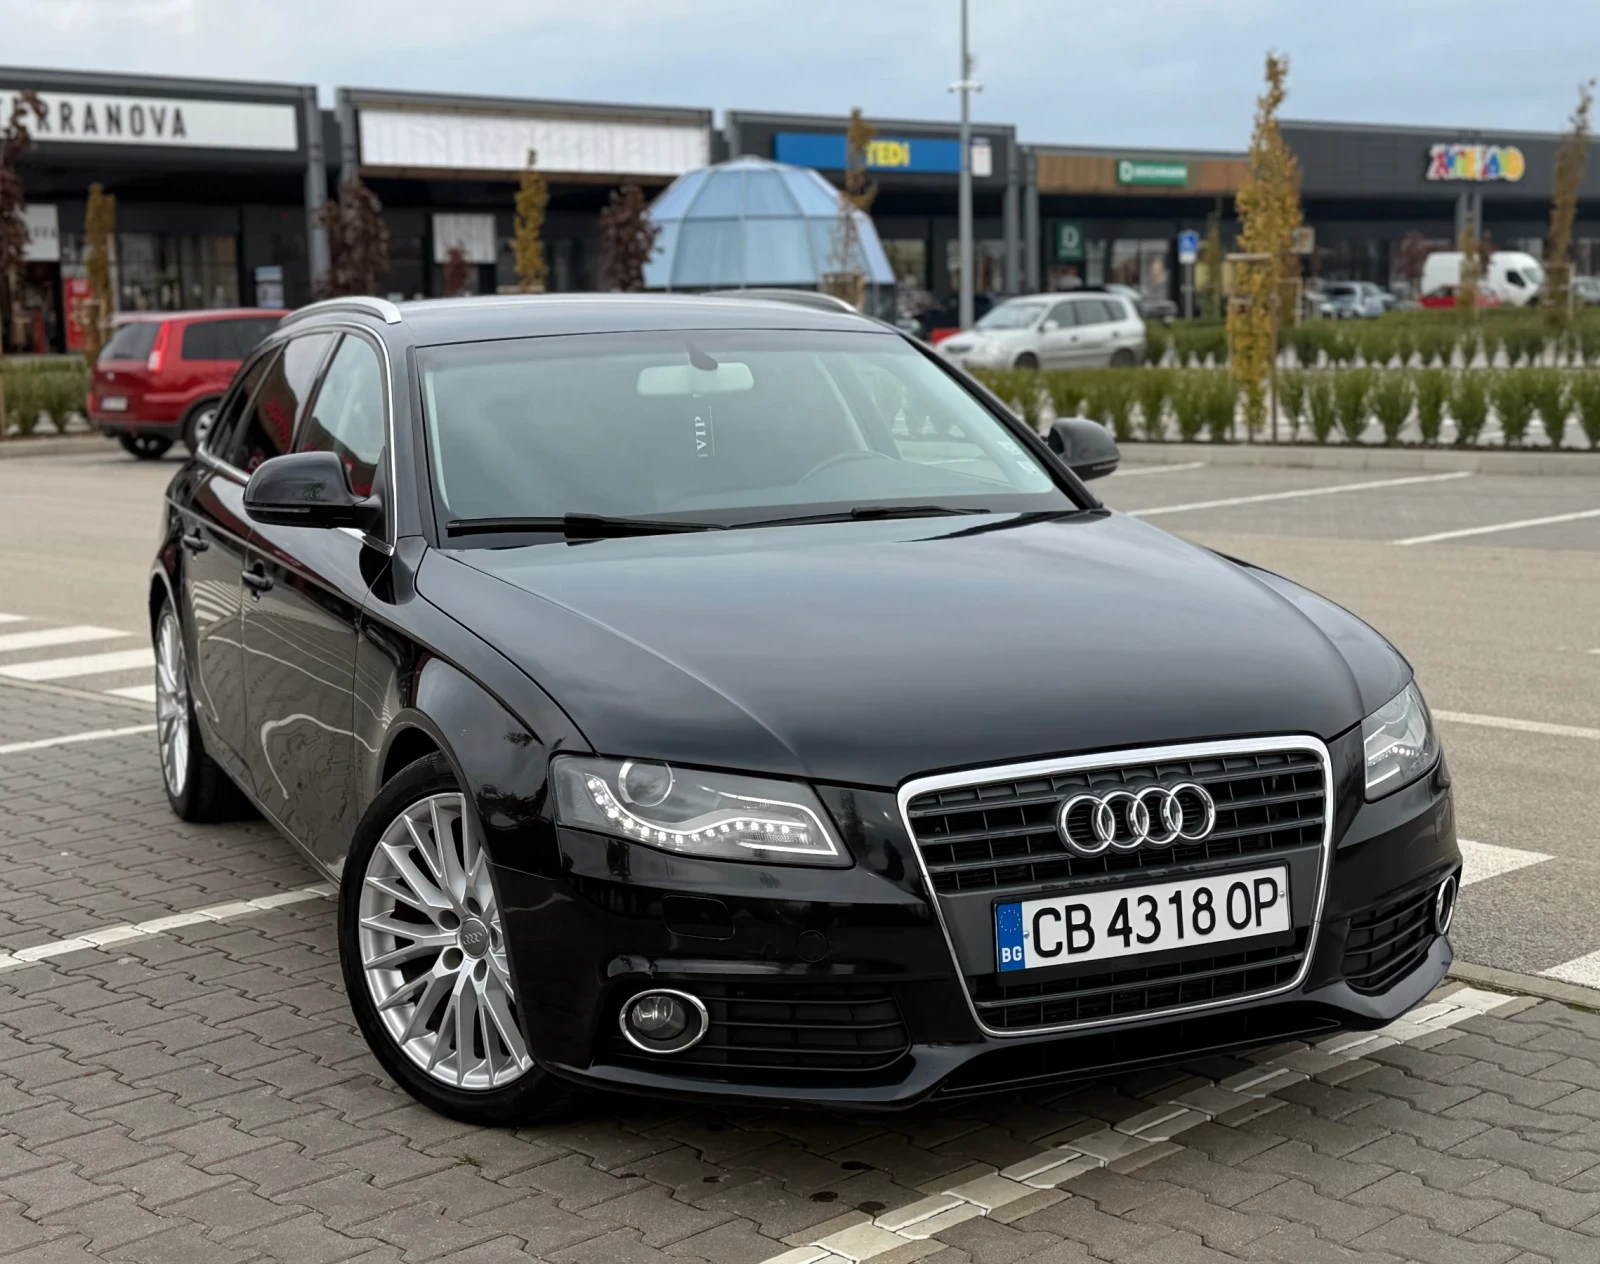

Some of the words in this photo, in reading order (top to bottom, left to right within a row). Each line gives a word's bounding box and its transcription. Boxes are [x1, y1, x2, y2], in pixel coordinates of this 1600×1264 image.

[0, 96, 187, 138] RRANOVA
[694, 416, 707, 451] VIP
[1032, 903, 1095, 958] CB
[1107, 886, 1217, 948] 4318
[1226, 877, 1279, 931] OP
[1001, 945, 1022, 963] BG
